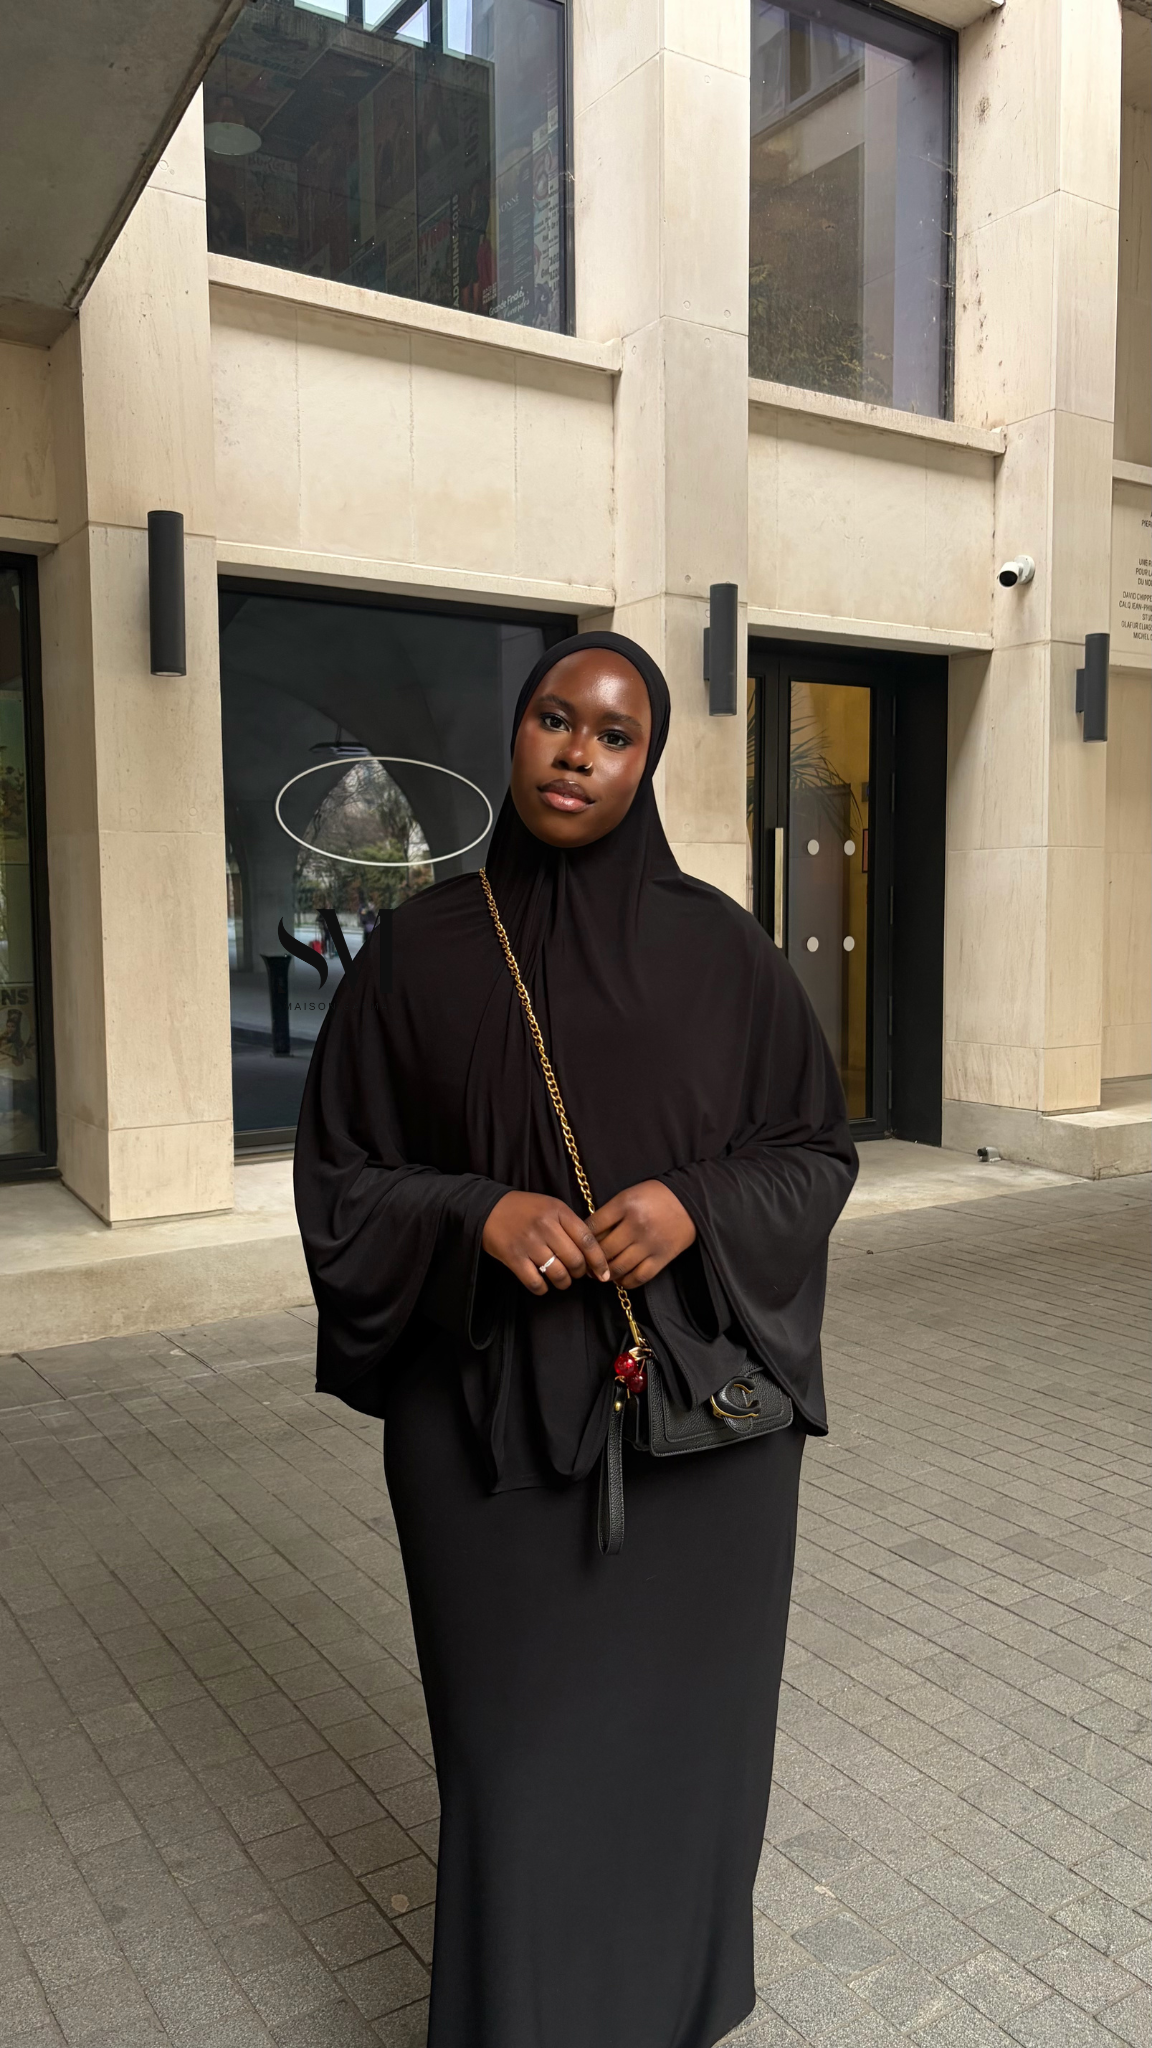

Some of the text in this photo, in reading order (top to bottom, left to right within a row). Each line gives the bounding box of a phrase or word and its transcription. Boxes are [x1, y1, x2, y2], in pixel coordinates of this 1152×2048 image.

[1135, 567, 1148, 576] POUR
[1137, 578, 1144, 586] DU
[1122, 591, 1136, 600] DAVID
[1133, 631, 1149, 641] MICHEL
